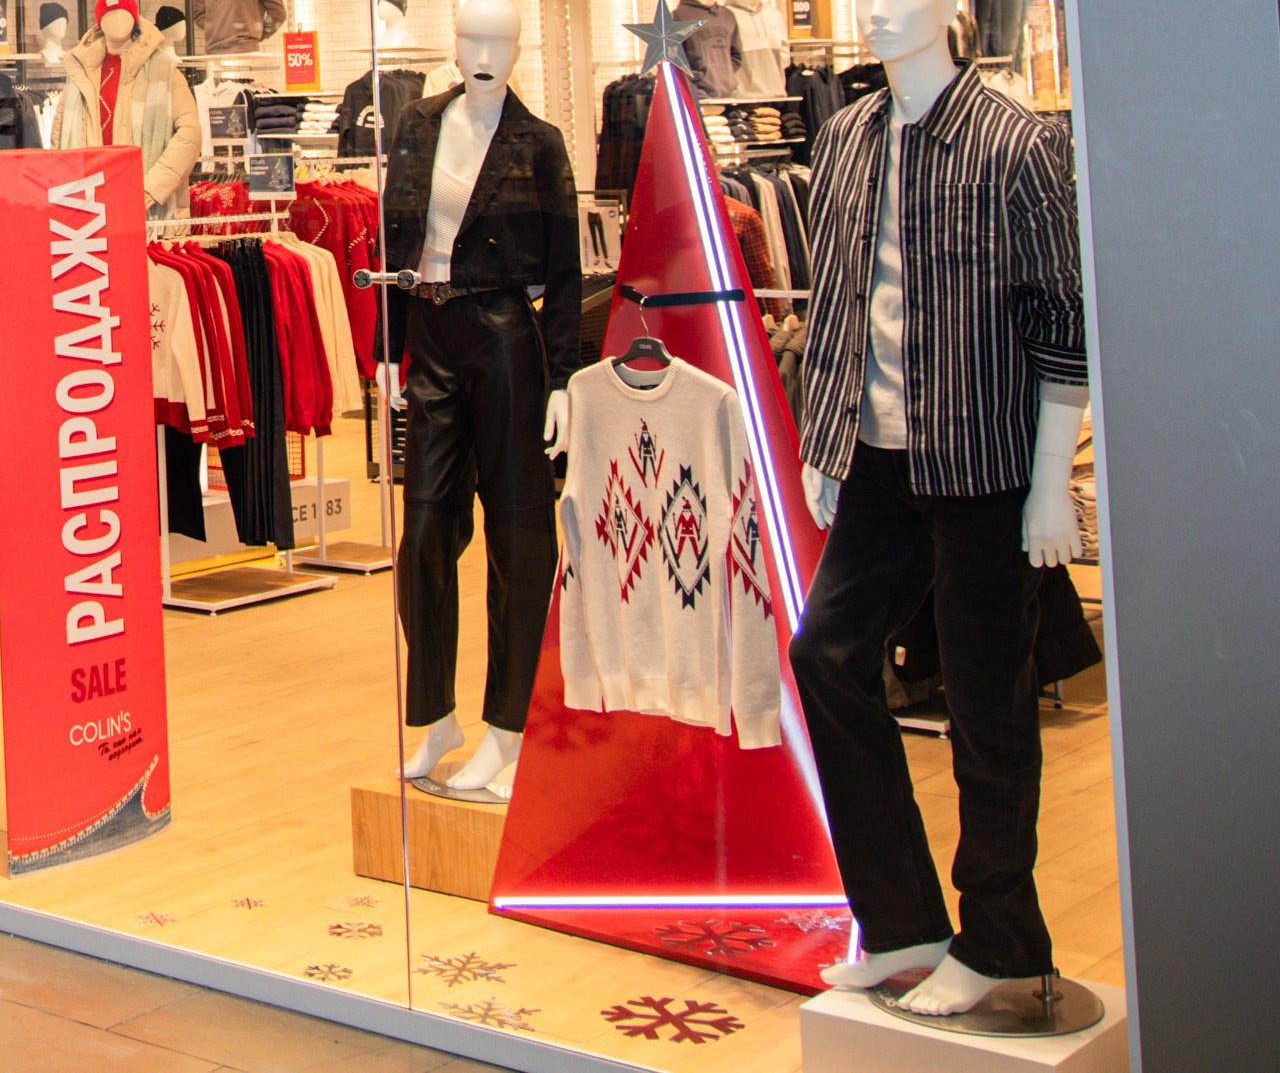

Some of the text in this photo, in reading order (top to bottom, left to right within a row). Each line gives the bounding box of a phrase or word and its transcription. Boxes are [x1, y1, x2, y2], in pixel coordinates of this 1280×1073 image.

[287, 53, 313, 67] 50%
[48, 171, 124, 644] РАСПРОДАЖА
[311, 497, 343, 520] 183
[71, 657, 127, 704] SALE
[69, 710, 132, 746] COLIN'S
